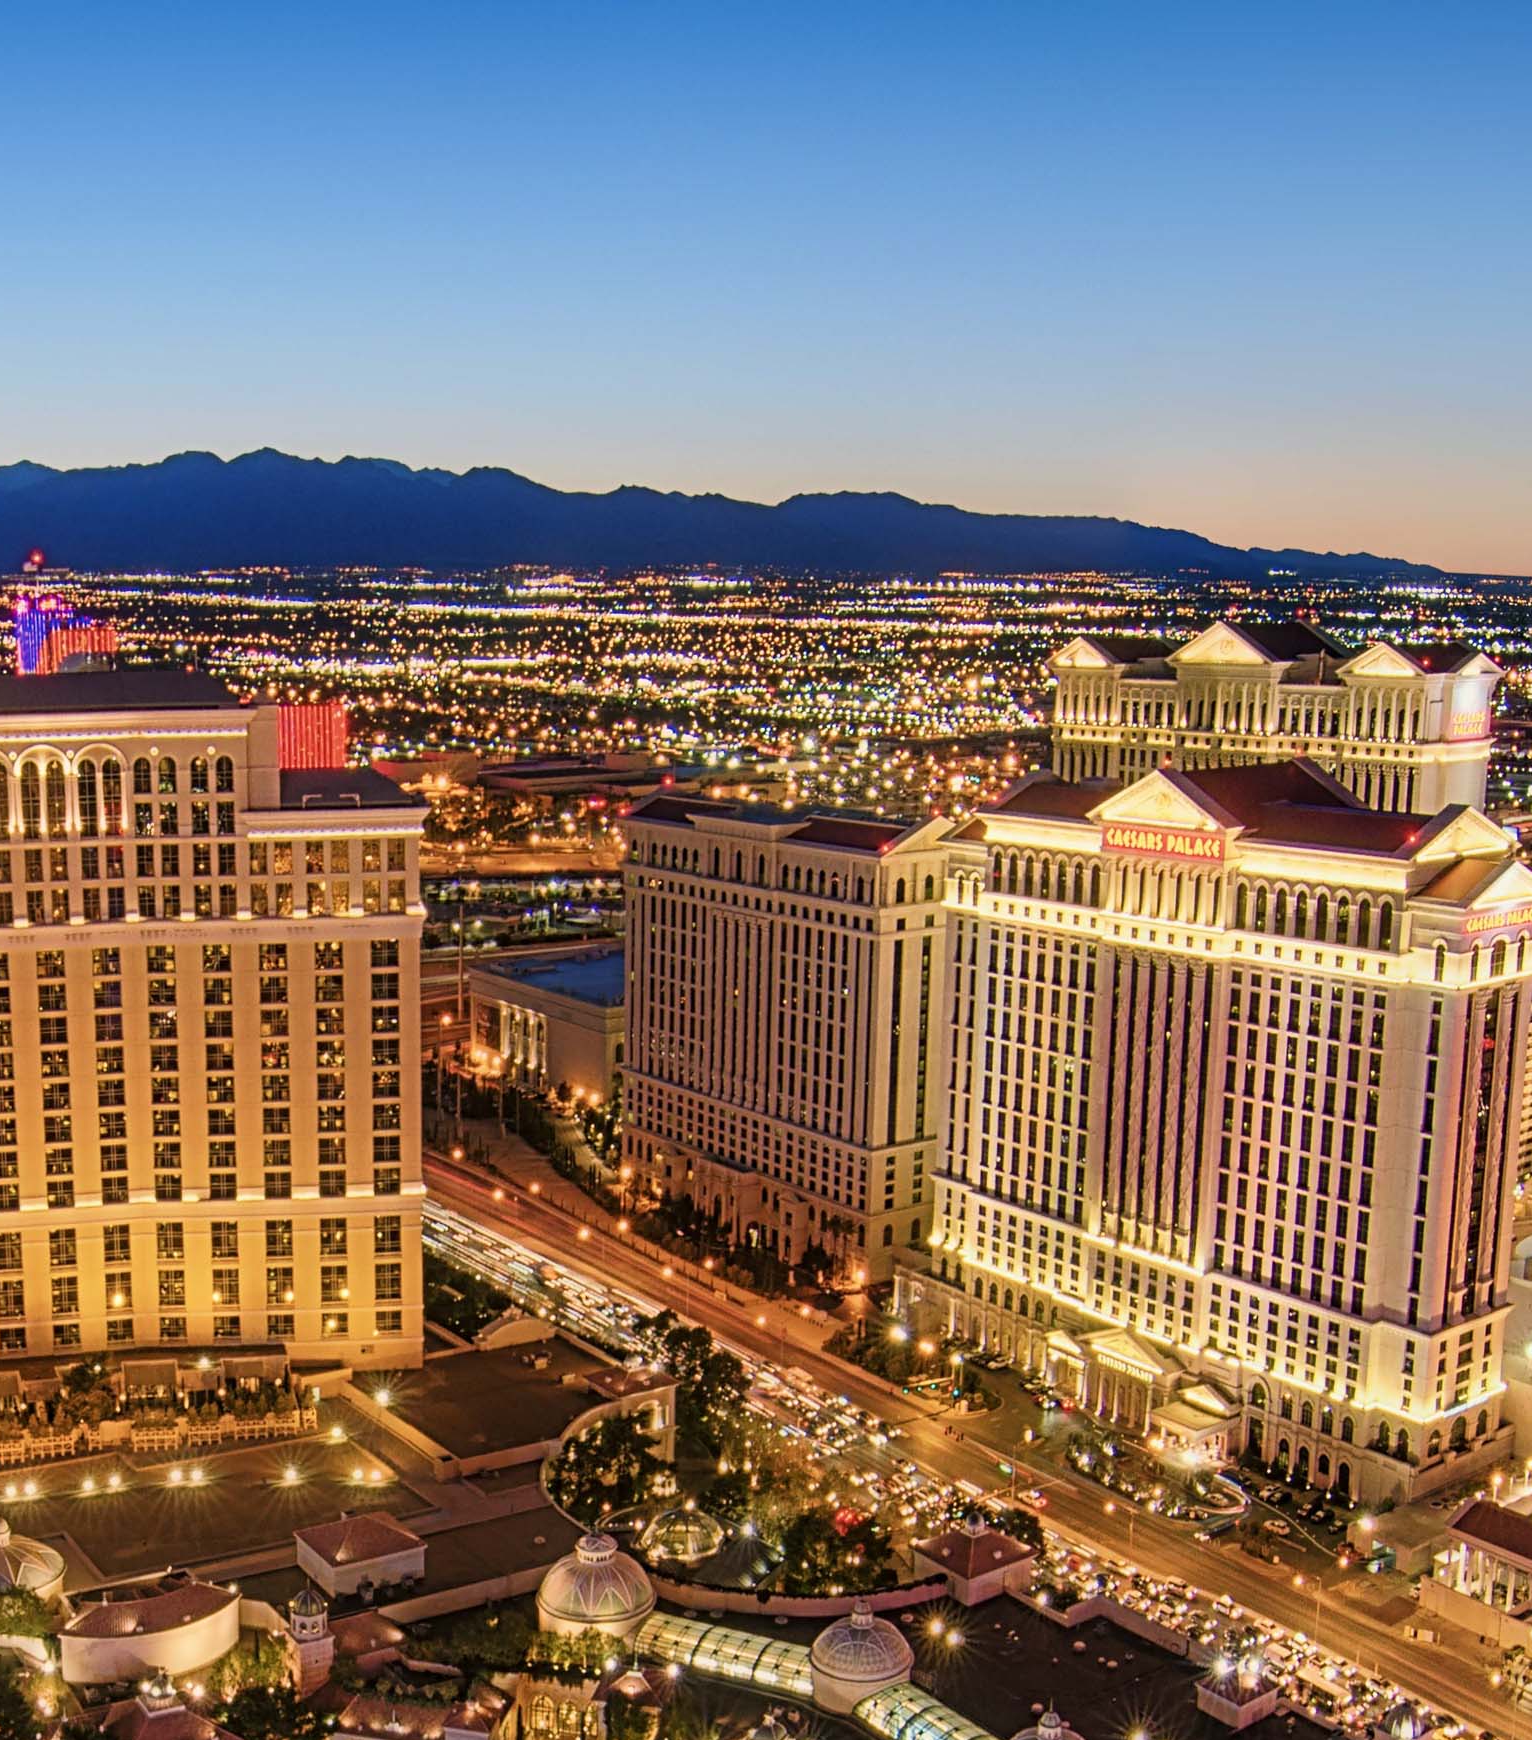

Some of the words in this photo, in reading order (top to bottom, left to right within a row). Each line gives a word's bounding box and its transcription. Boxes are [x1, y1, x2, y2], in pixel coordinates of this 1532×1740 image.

[1107, 827, 1163, 851] CAESARS
[1167, 835, 1221, 858] PALACE
[1467, 913, 1505, 933] CAESARS
